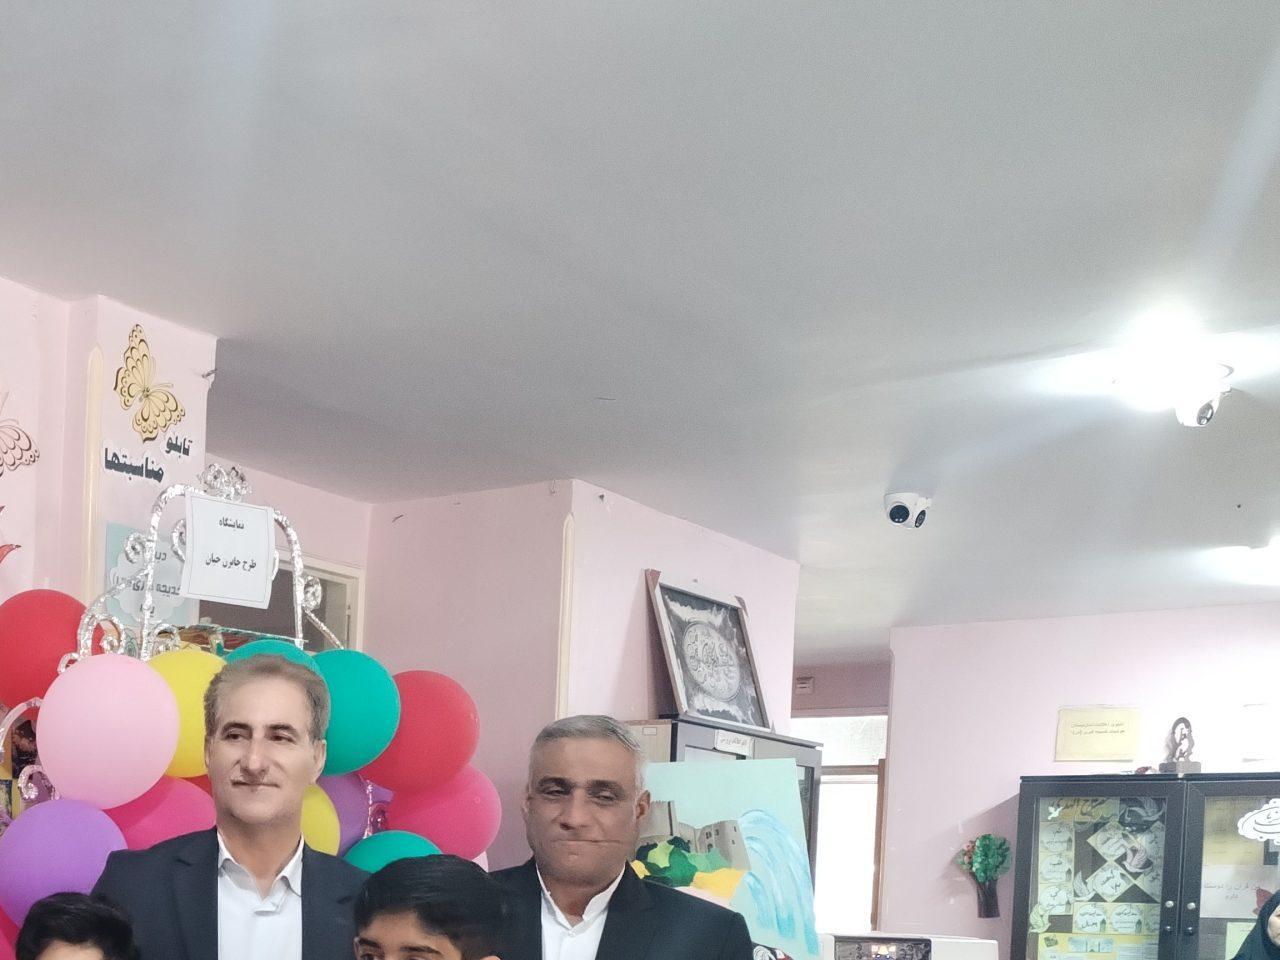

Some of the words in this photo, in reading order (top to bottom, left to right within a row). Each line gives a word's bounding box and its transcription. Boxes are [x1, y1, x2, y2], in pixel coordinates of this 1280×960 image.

[165, 435, 193, 459] تابلو
[104, 447, 164, 483] مناسبتها
[218, 516, 245, 531] نمایشگاه
[241, 558, 257, 572] طرح
